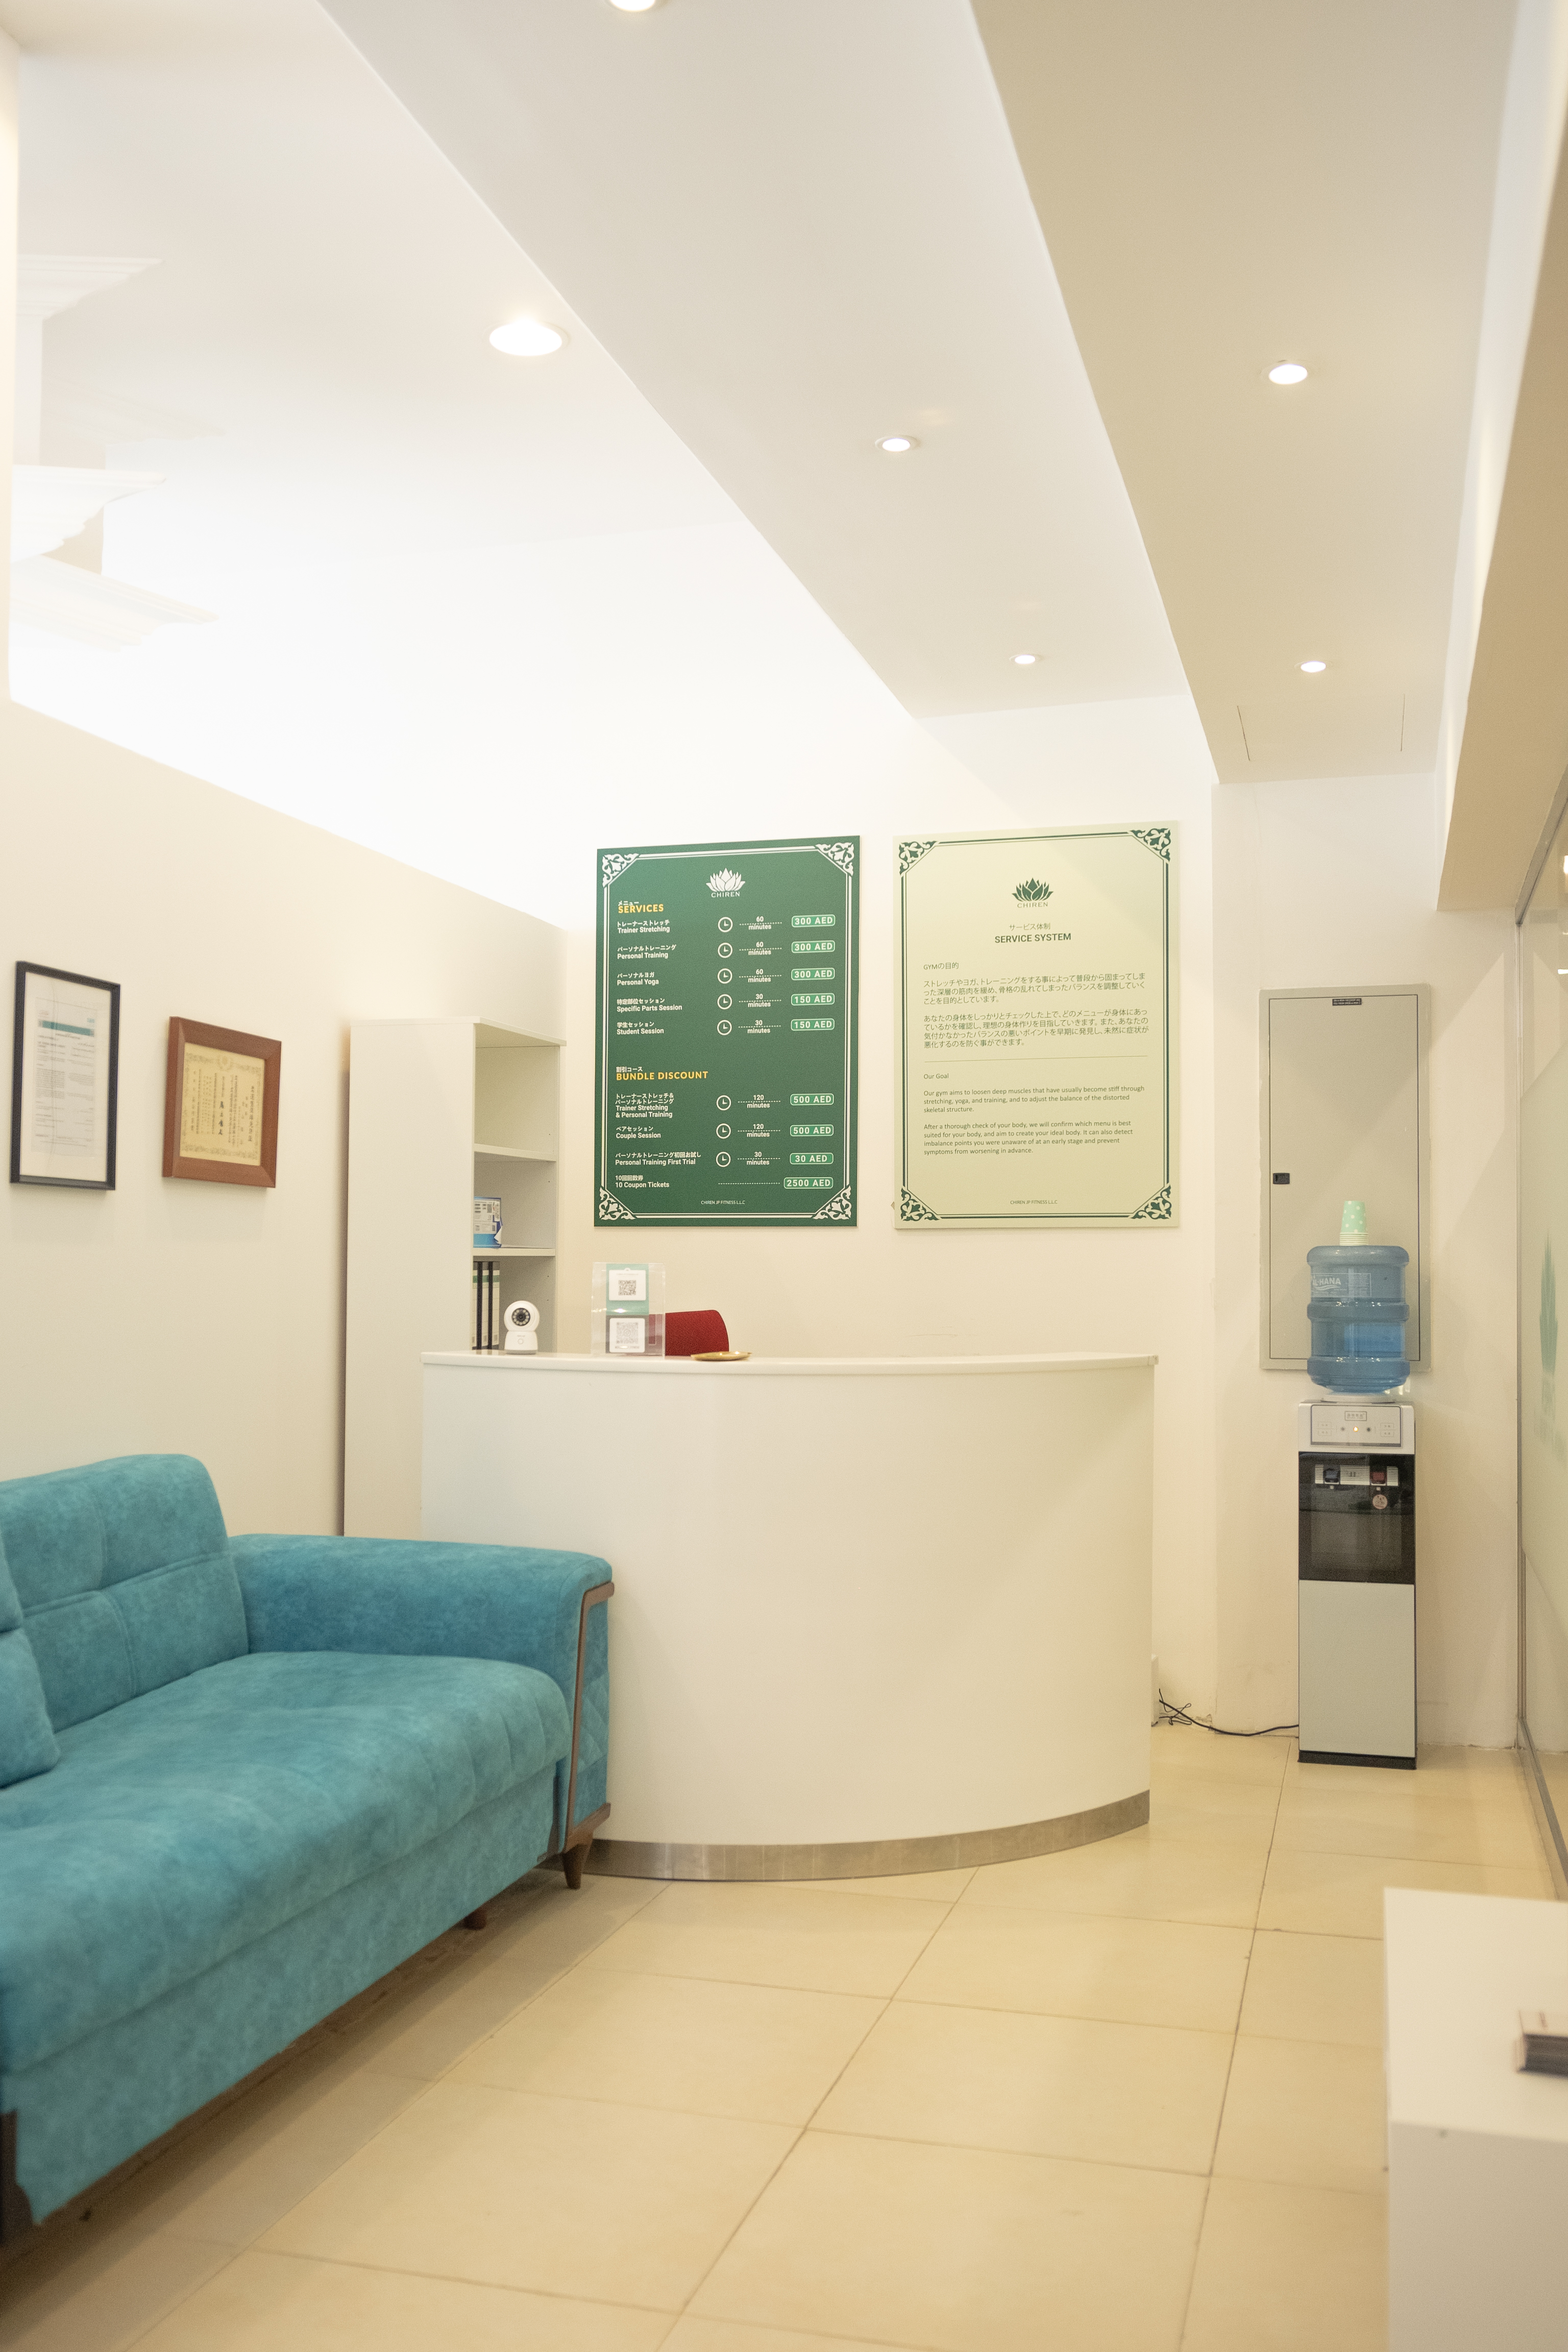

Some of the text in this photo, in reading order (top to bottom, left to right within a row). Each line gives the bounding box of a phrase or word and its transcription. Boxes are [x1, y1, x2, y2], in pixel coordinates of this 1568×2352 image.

[618, 904, 664, 913] SERVICES
[795, 917, 811, 925] 300
[995, 933, 1071, 943] SERVICE SYSTEM
[794, 942, 834, 951] 300 AED
[924, 995, 999, 1004] ことを目的としています。
[814, 1020, 834, 1028] AED
[658, 1071, 708, 1080] DISCOUNT
[813, 1126, 832, 1134] AED
